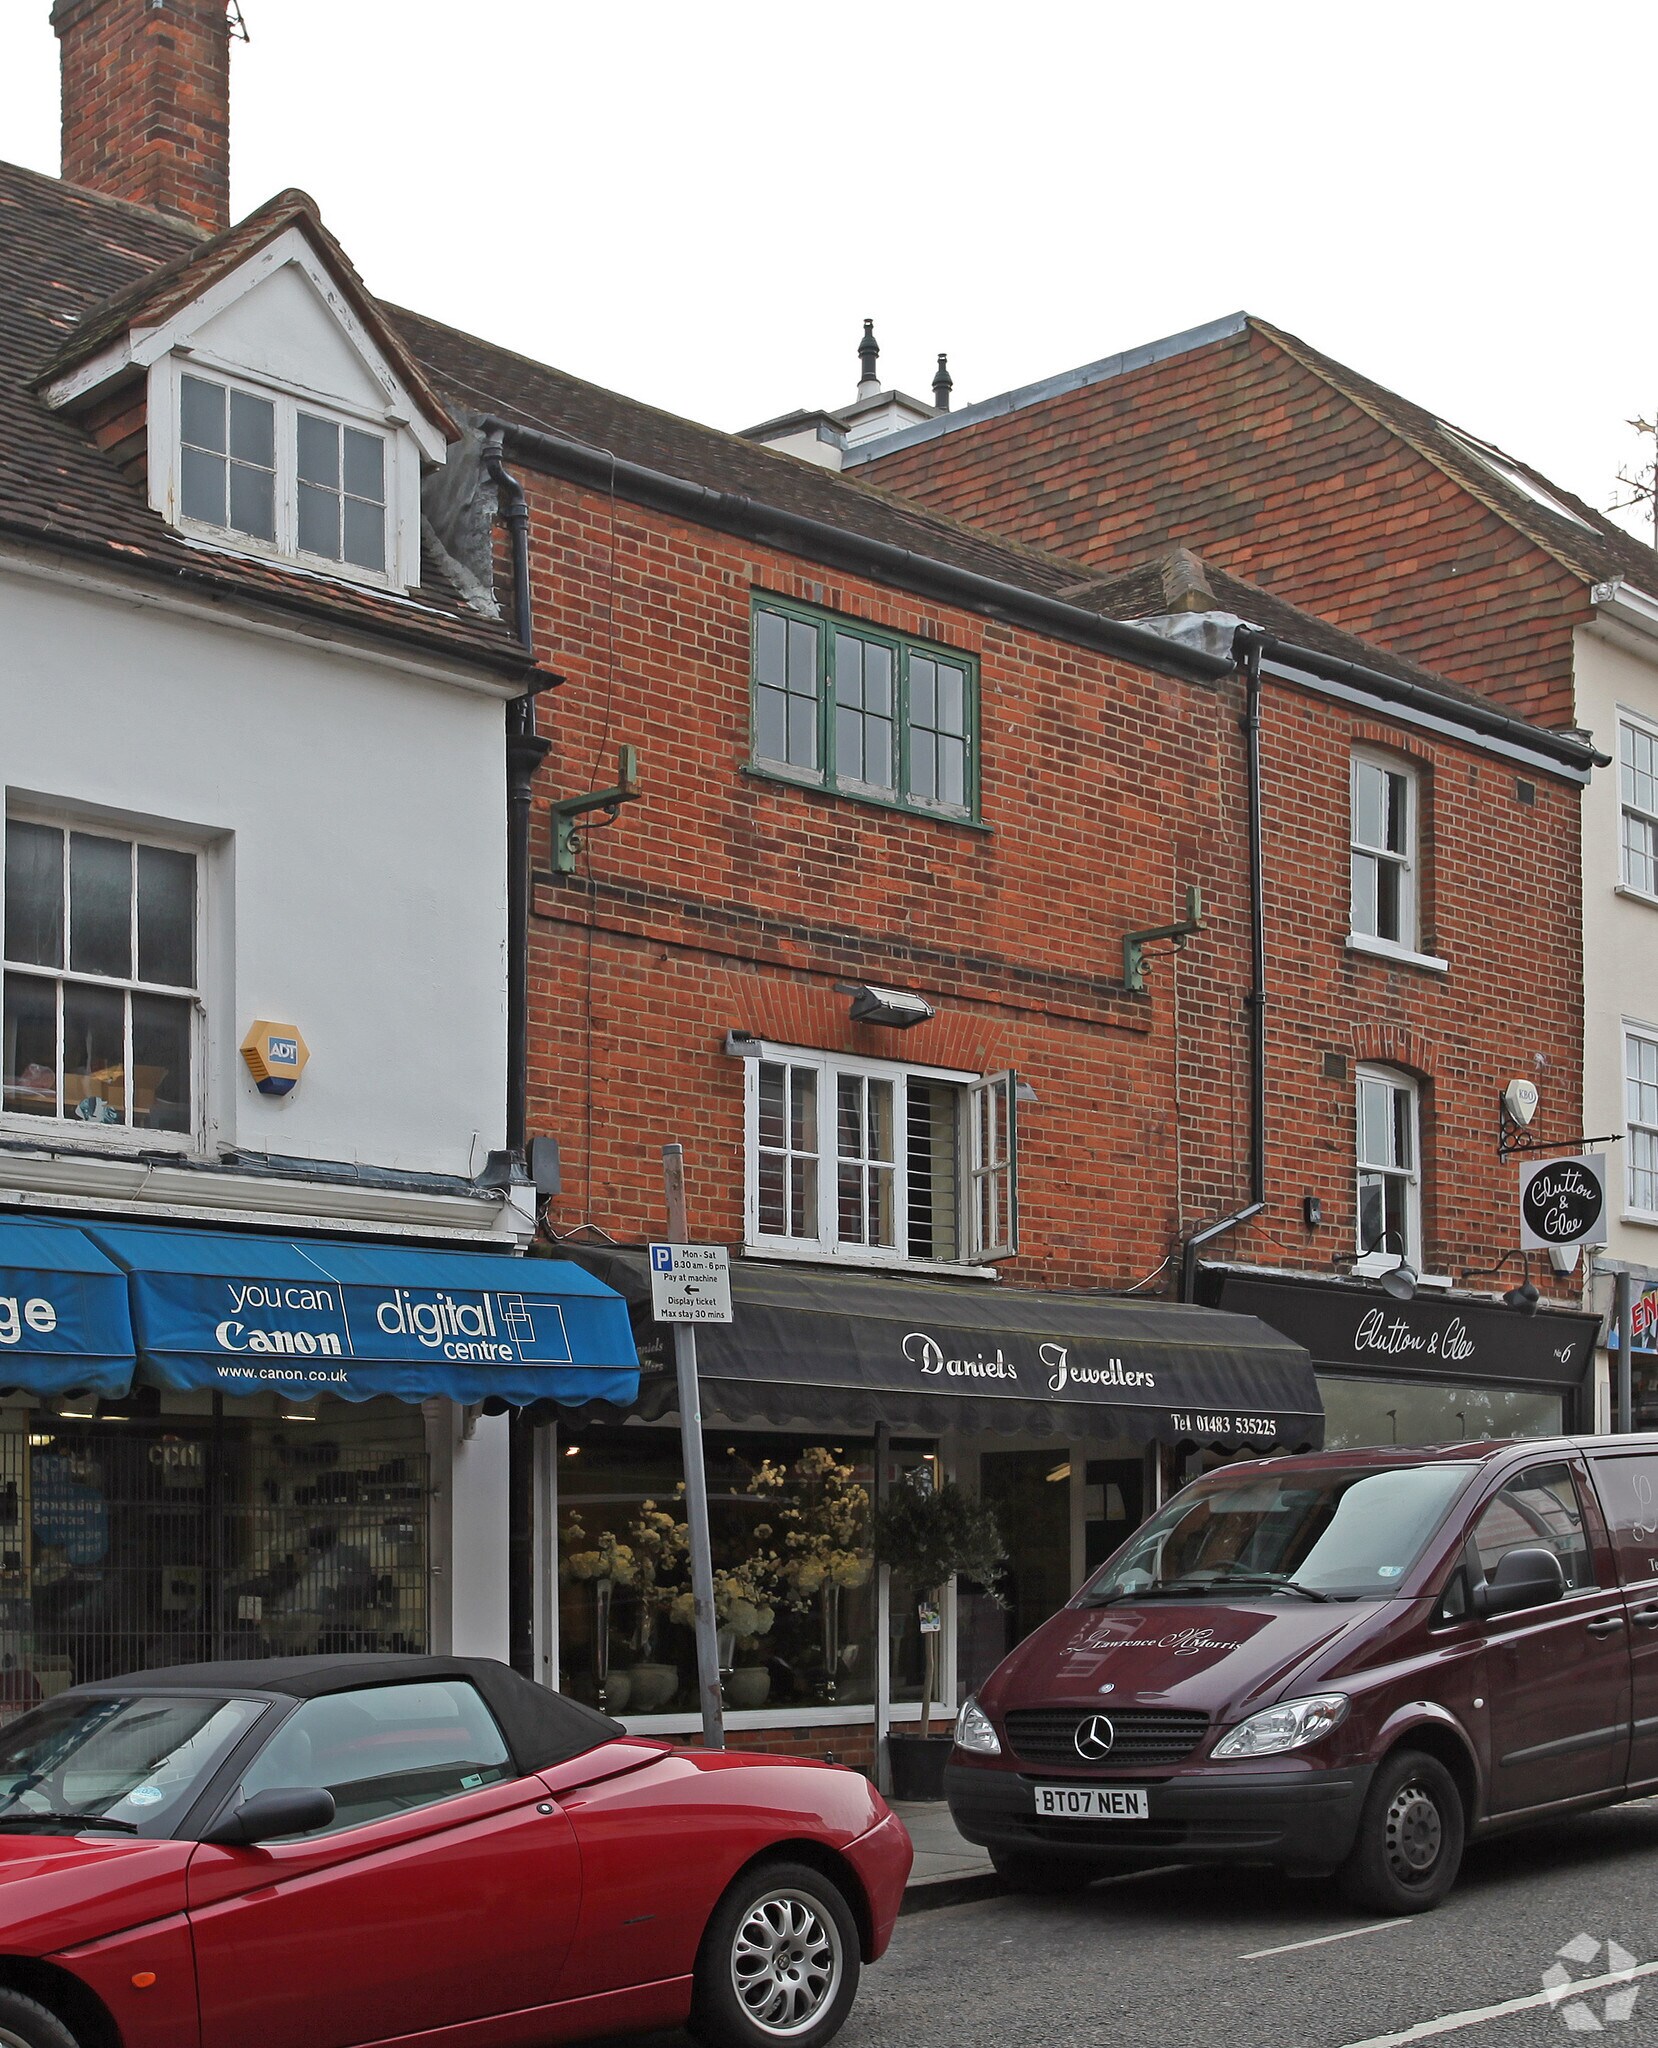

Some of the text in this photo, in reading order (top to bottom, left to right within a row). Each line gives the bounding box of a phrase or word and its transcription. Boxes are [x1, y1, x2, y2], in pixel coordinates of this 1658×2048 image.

[270, 1042, 297, 1059] ADT
[1531, 1168, 1596, 1207] Glutton
[1559, 1195, 1569, 1209] &
[1544, 1207, 1582, 1235] Glee
[656, 1249, 669, 1269] P
[682, 1250, 698, 1259] Mon
[703, 1251, 716, 1259] Sat
[708, 1262, 714, 1270] 6
[664, 1273, 677, 1282] Pay
[227, 1284, 334, 1314] you can
[668, 1297, 716, 1306] Display ticket
[376, 1289, 497, 1347] digital
[679, 1310, 694, 1319] stay
[695, 1310, 706, 1318] 30
[215, 1321, 342, 1355] Canon
[1354, 1308, 1476, 1360] Glutton & Glee
[444, 1340, 513, 1361] centre
[1560, 1342, 1577, 1364] 6
[902, 1332, 1155, 1392] Daniels Jewellers
[217, 1367, 348, 1382] www.canon.co.uk
[1170, 1413, 1276, 1436] Tel 01483 535225
[1042, 1791, 1139, 1814] BT07 NEN
